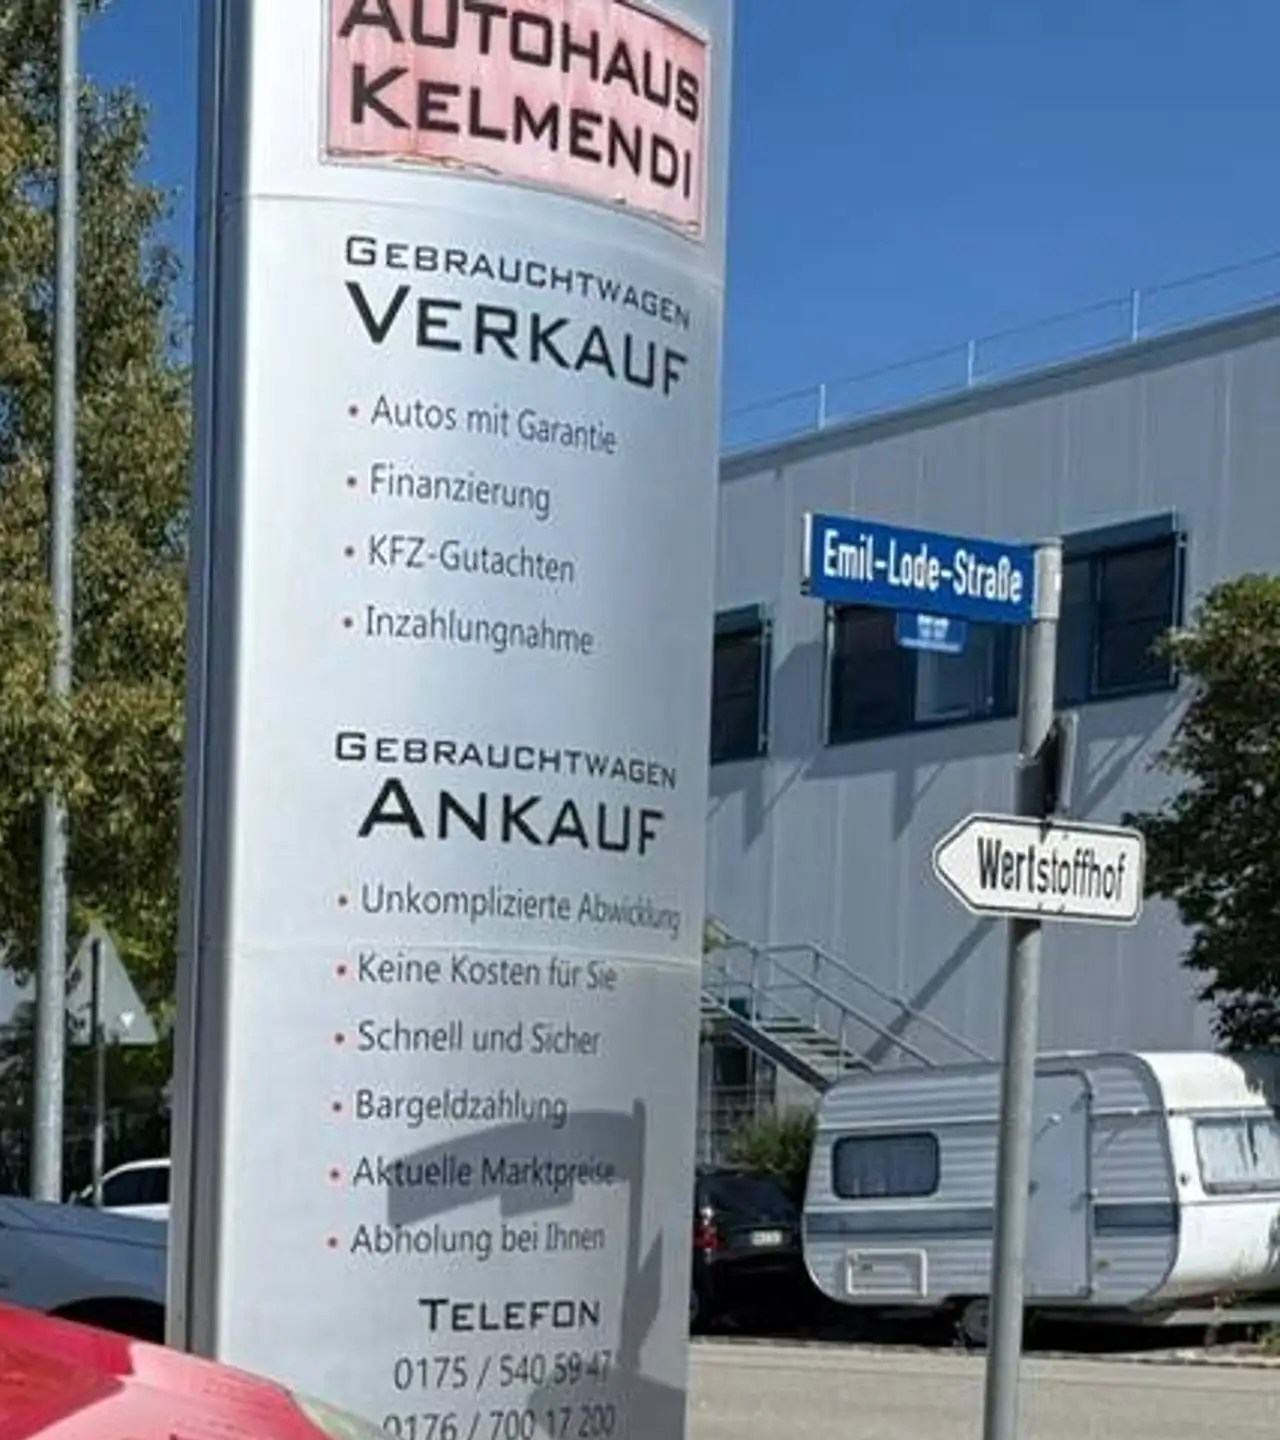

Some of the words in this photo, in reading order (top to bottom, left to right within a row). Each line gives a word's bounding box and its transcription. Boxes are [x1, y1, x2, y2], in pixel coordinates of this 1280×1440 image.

[338, 0, 700, 122] AUTOHAUS
[350, 63, 691, 199] KELMENDI
[345, 235, 689, 329] GEBRAUCHTWAGEN
[345, 281, 688, 396] VERKAUF
[371, 395, 456, 430] Autos
[466, 402, 509, 437] mit
[517, 408, 617, 455] Garantie
[370, 463, 551, 521] Finanzierung
[368, 535, 575, 583] KFZ-Gutachten
[823, 528, 1024, 604] Emil-Lode-Straße
[365, 605, 595, 655] Inzahlungnahme
[335, 732, 676, 790] GEBRAUCHTWAGEN
[358, 777, 665, 855] ANKAUF
[977, 837, 1126, 901] Wertstoffhof
[361, 881, 571, 925] Unkomplizierte
[578, 892, 682, 941] Abwicklung
[358, 952, 440, 984] Keine
[451, 956, 540, 988] Kosten
[548, 960, 581, 989] für
[586, 960, 618, 991] Sie
[357, 1018, 463, 1053] Schnell
[473, 1022, 523, 1053] und
[531, 1022, 602, 1056] Sicher
[355, 1089, 568, 1129] Bargeldzahlung
[353, 1156, 472, 1188] Aktuelle
[481, 1157, 616, 1190] Marktpreise
[350, 1223, 492, 1262] Abholung
[501, 1221, 539, 1252] bei
[546, 1221, 607, 1252] Ihnen
[418, 1298, 601, 1332] TELEFON
[394, 1356, 468, 1390] 0175
[499, 1352, 546, 1387] 540
